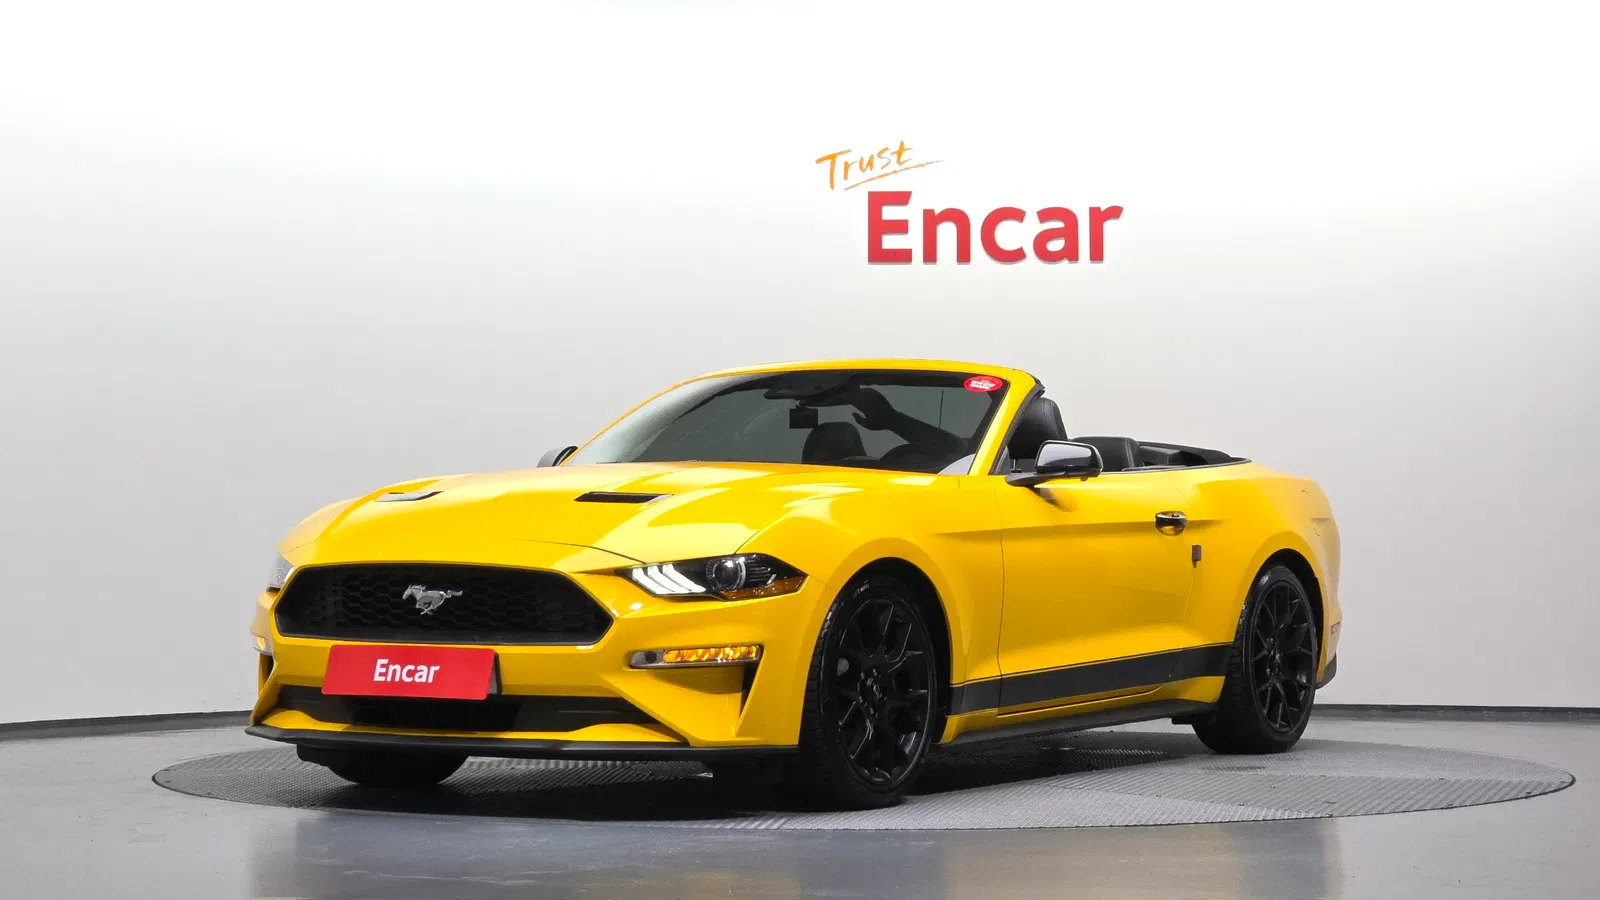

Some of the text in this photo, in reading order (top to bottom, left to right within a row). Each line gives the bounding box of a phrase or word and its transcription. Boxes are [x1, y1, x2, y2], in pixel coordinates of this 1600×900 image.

[815, 140, 914, 190] Trust
[868, 191, 1124, 264] Encar
[373, 658, 441, 683] Encar
